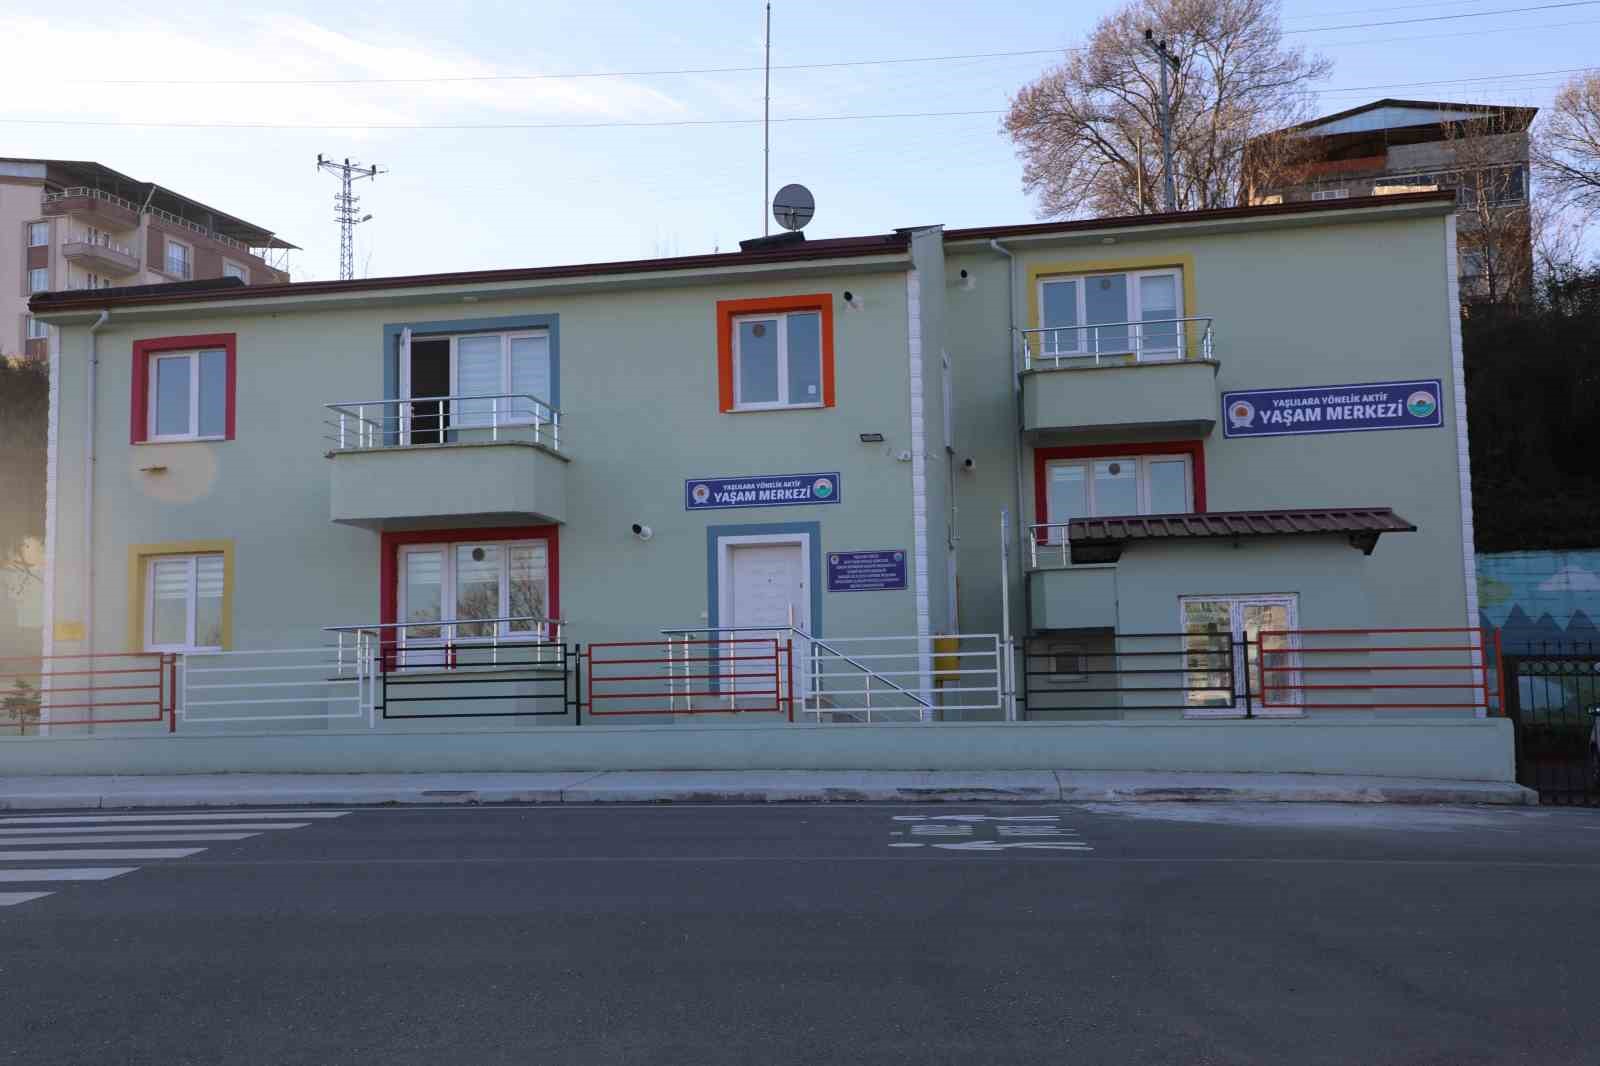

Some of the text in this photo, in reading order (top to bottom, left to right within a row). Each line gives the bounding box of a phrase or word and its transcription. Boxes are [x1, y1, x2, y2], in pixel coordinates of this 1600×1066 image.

[1272, 391, 1389, 408] YAŞLILARA YÖNELİK AKTİF
[1260, 399, 1403, 427] YAŞAM MERKEZİ
[714, 485, 811, 504] YAŞAM MERKEZİ
